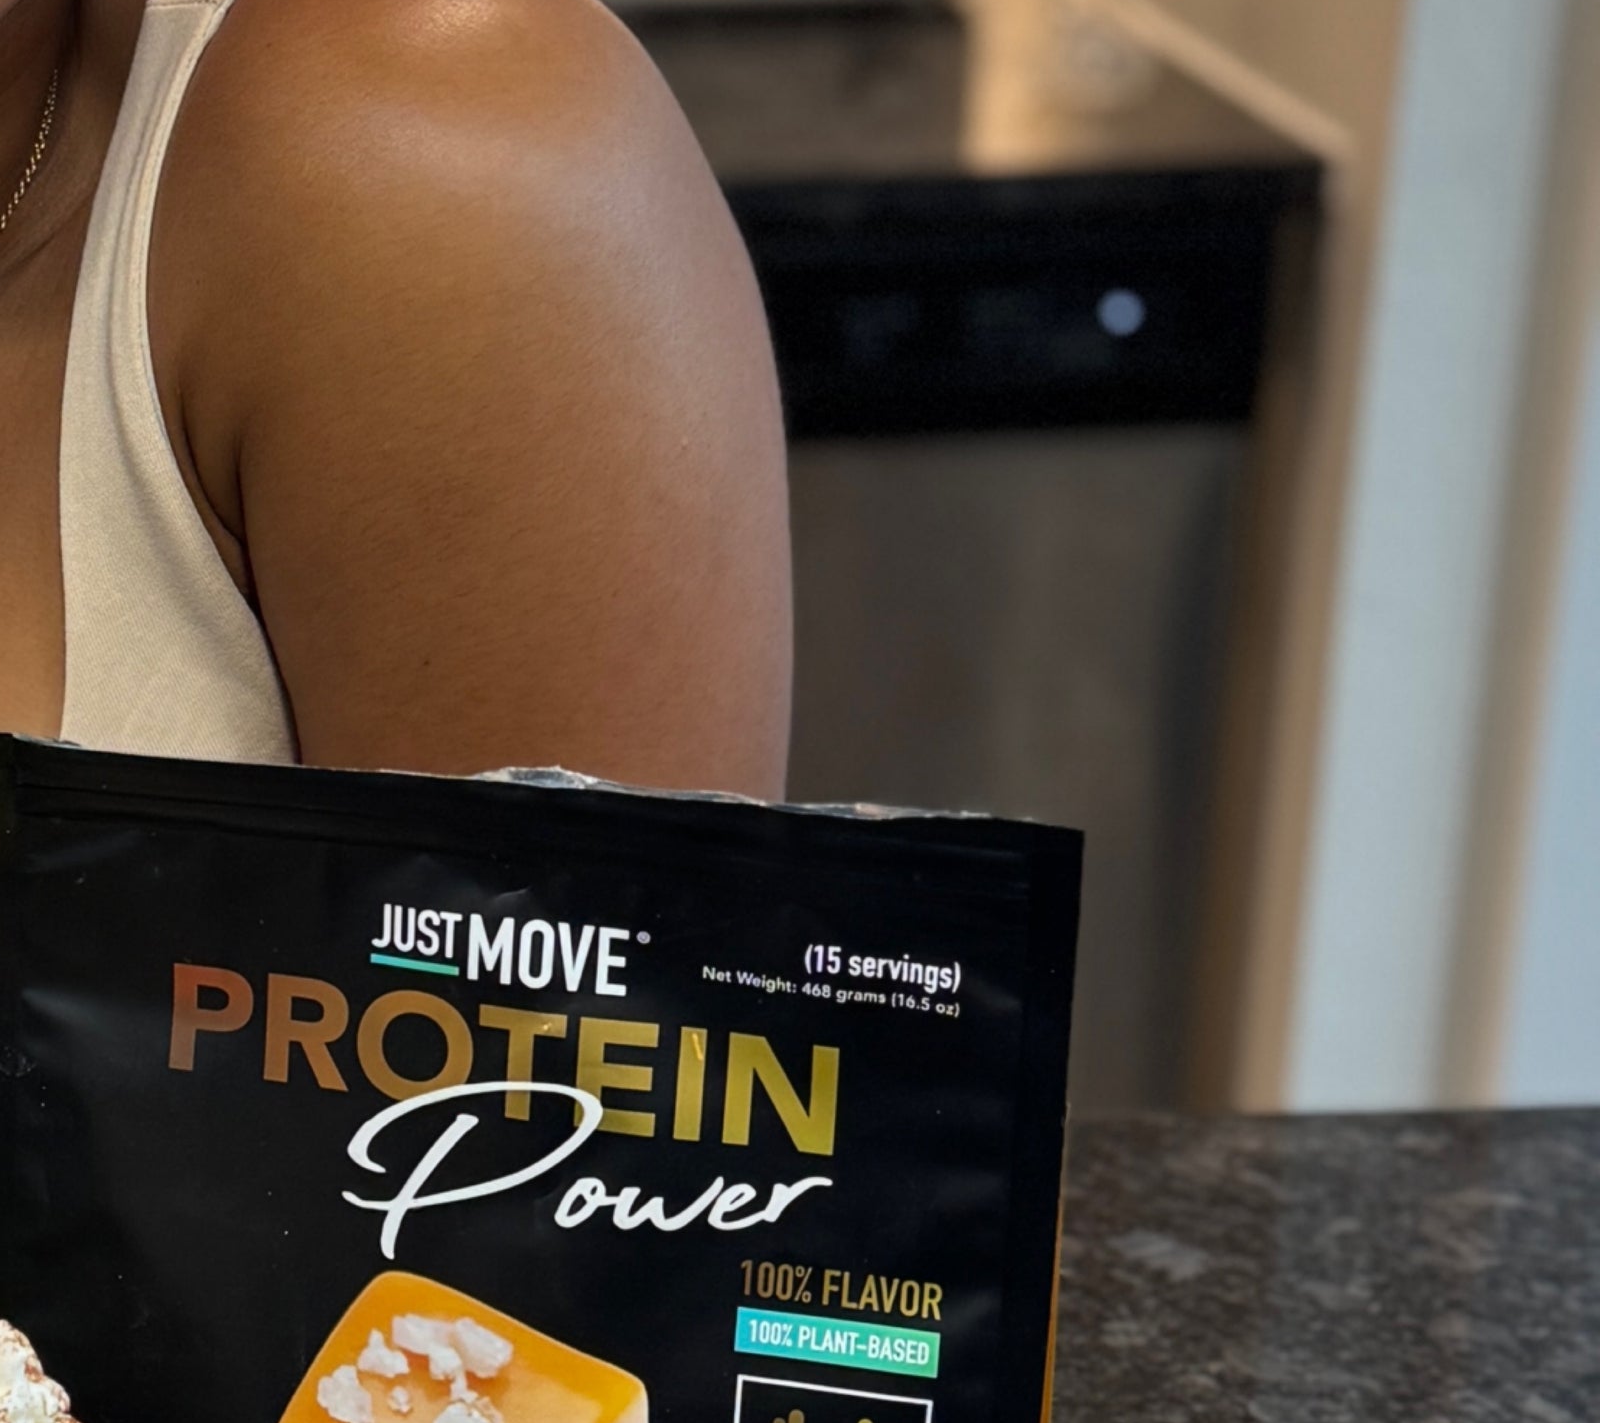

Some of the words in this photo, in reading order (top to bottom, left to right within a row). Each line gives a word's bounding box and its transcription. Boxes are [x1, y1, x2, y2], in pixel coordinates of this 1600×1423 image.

[371, 903, 463, 959] JUST
[702, 965, 732, 983] Net
[736, 970, 798, 994] Weight:
[801, 981, 832, 999] 468
[836, 988, 887, 1004] grams
[891, 992, 931, 1012] (16.5
[934, 1002, 960, 1018] oz)
[804, 944, 842, 974] (15
[848, 953, 962, 994] servings)
[167, 962, 840, 1157] PROTEIN
[341, 1080, 834, 1259] Power
[740, 1259, 813, 1304] 100%
[821, 1269, 943, 1321] FLAVOR
[749, 1319, 794, 1347] 100%
[796, 1326, 931, 1366] PLANT-BASED
